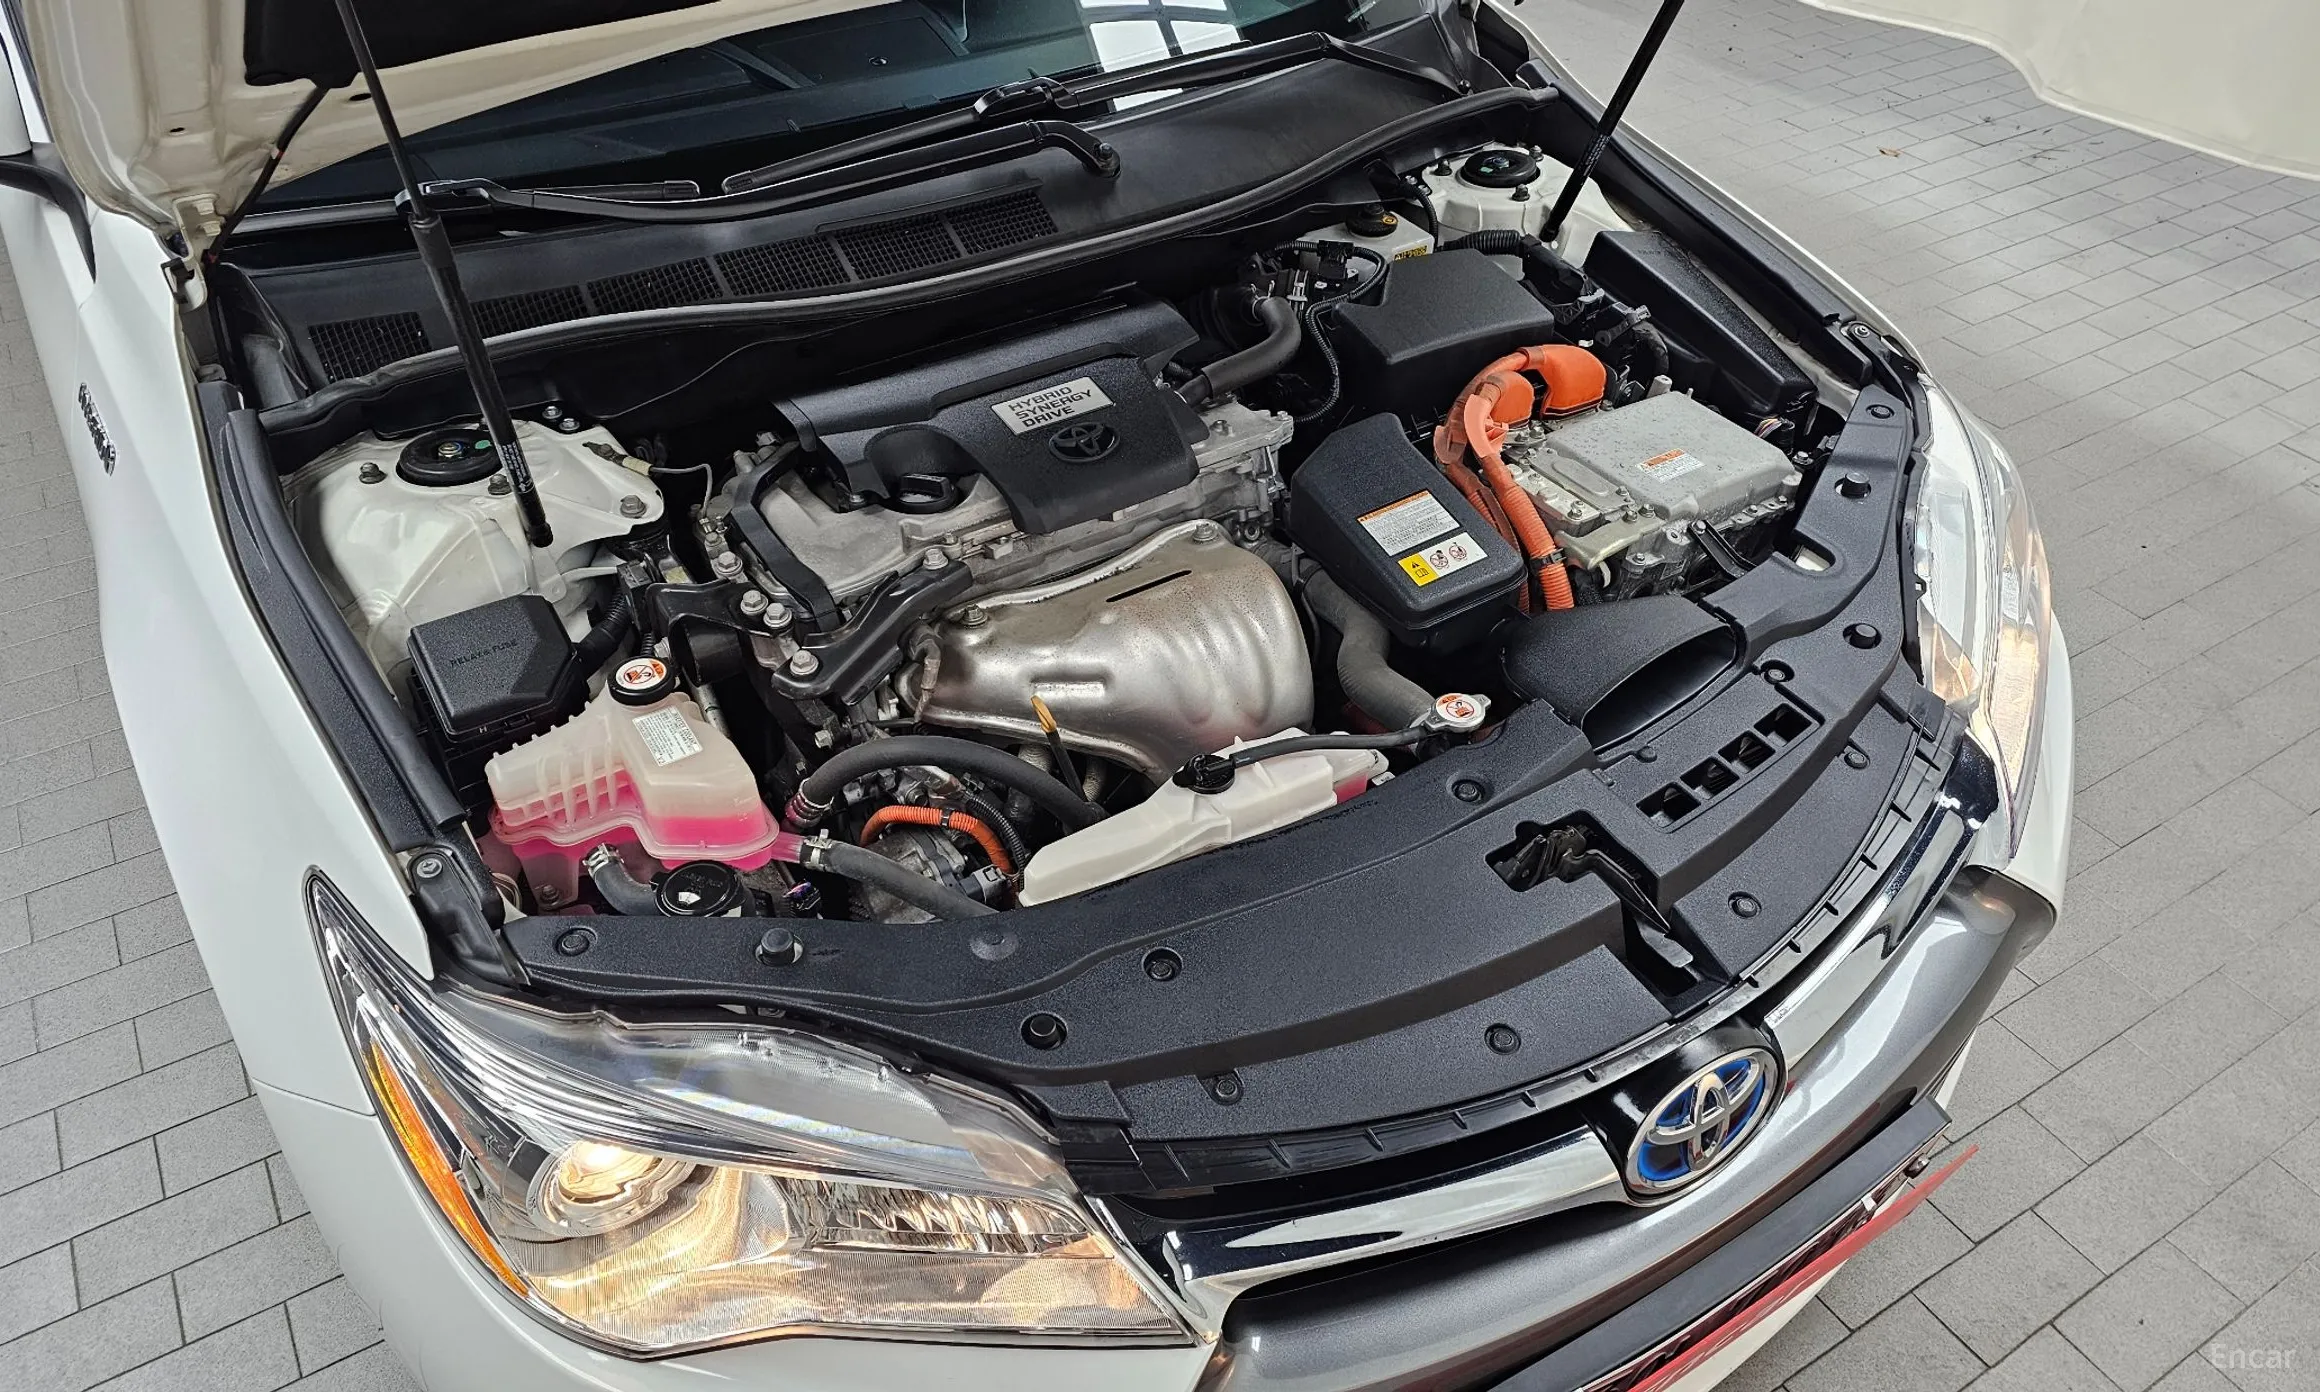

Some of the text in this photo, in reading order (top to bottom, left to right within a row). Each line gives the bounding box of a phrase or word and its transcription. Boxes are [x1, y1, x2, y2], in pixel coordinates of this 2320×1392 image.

[1009, 387, 1072, 411] HYBRID
[1016, 389, 1092, 419] SYNERGY
[1023, 406, 1075, 427] DRIVE
